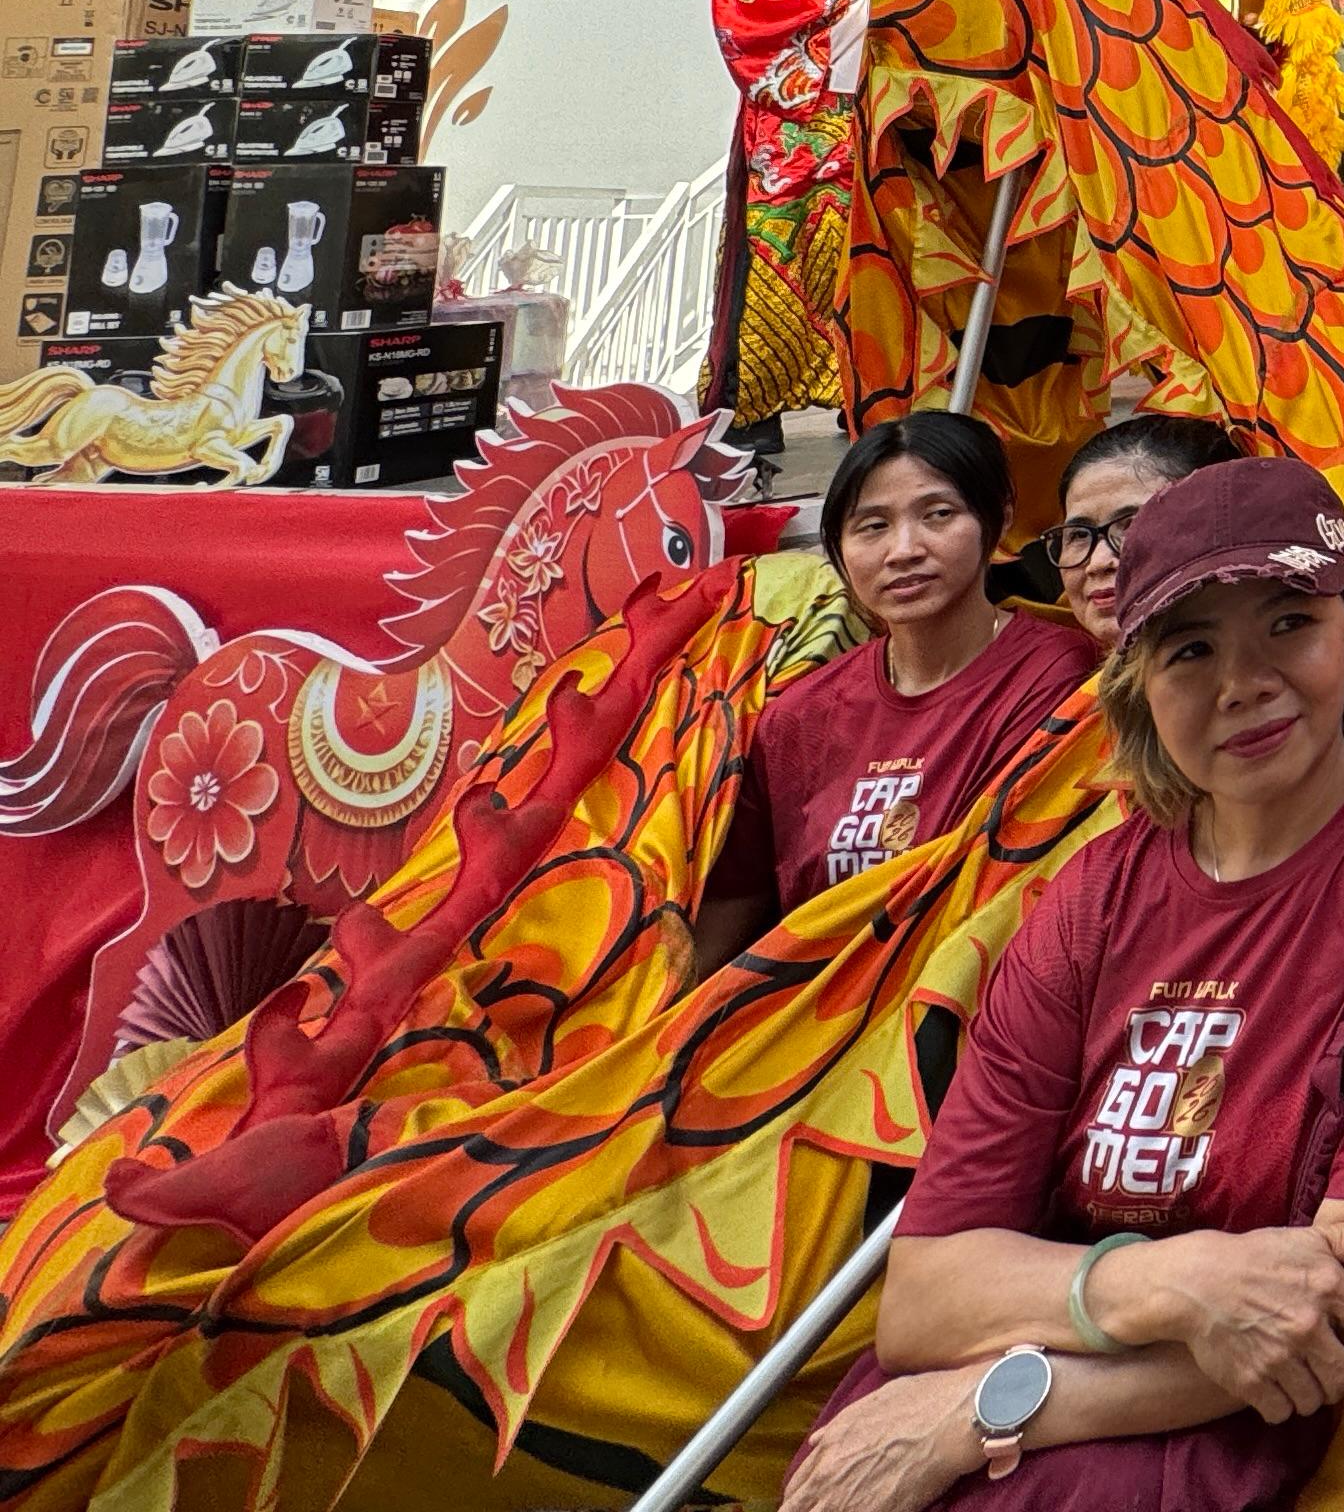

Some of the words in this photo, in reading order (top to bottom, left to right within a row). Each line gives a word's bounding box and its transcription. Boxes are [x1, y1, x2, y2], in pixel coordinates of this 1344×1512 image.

[369, 335, 422, 348] SHARP
[851, 774, 922, 813] CAP
[831, 813, 884, 850] GO
[1150, 981, 1191, 1001] FUN
[1192, 981, 1240, 1000] WALK
[1129, 1010, 1242, 1066] CAP
[1097, 1068, 1178, 1130] GO
[1177, 1098, 1218, 1123] 26
[1082, 1129, 1211, 1194] MEH
